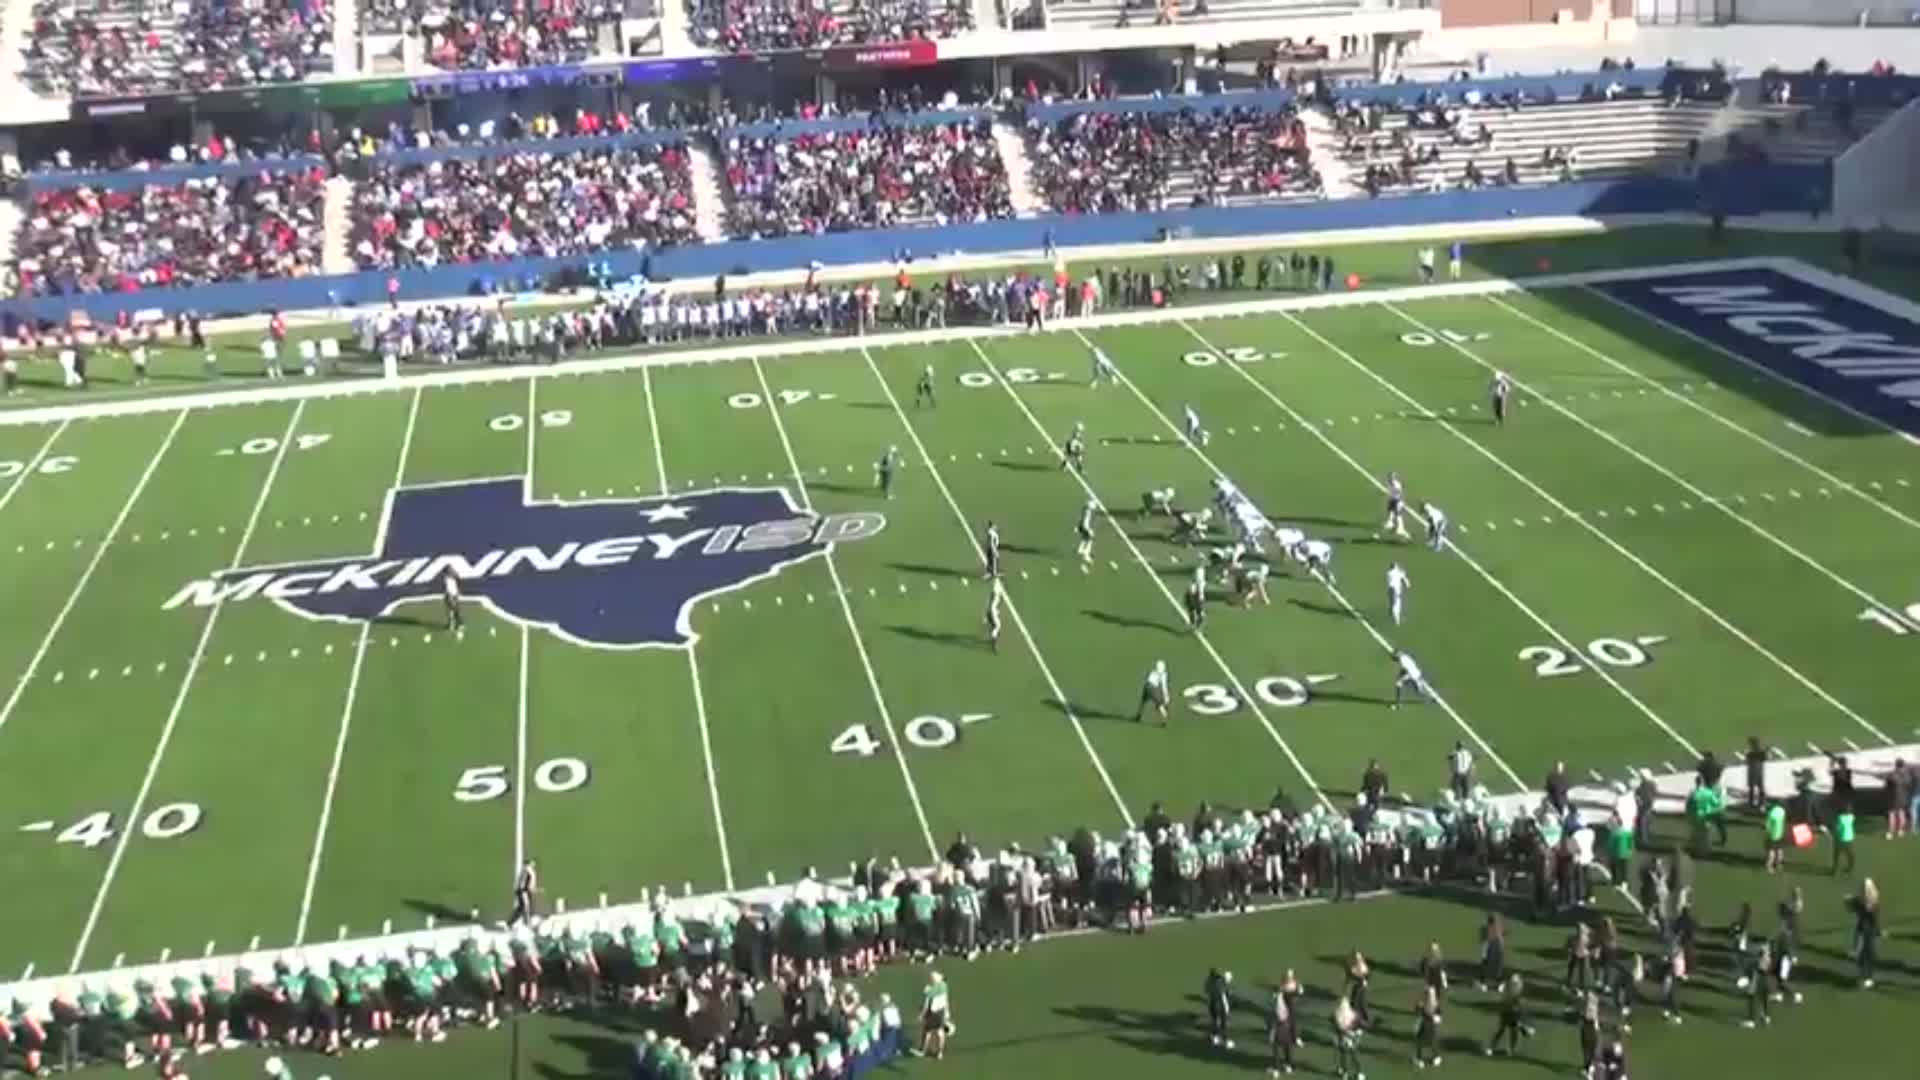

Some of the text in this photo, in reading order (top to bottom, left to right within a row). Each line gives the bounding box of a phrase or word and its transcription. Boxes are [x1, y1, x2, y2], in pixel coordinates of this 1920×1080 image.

[1518, 638, 1646, 676] 20
[1183, 676, 1308, 714] 30
[831, 715, 957, 755] 40
[453, 758, 588, 801] 50
[56, 803, 201, 847] 40
